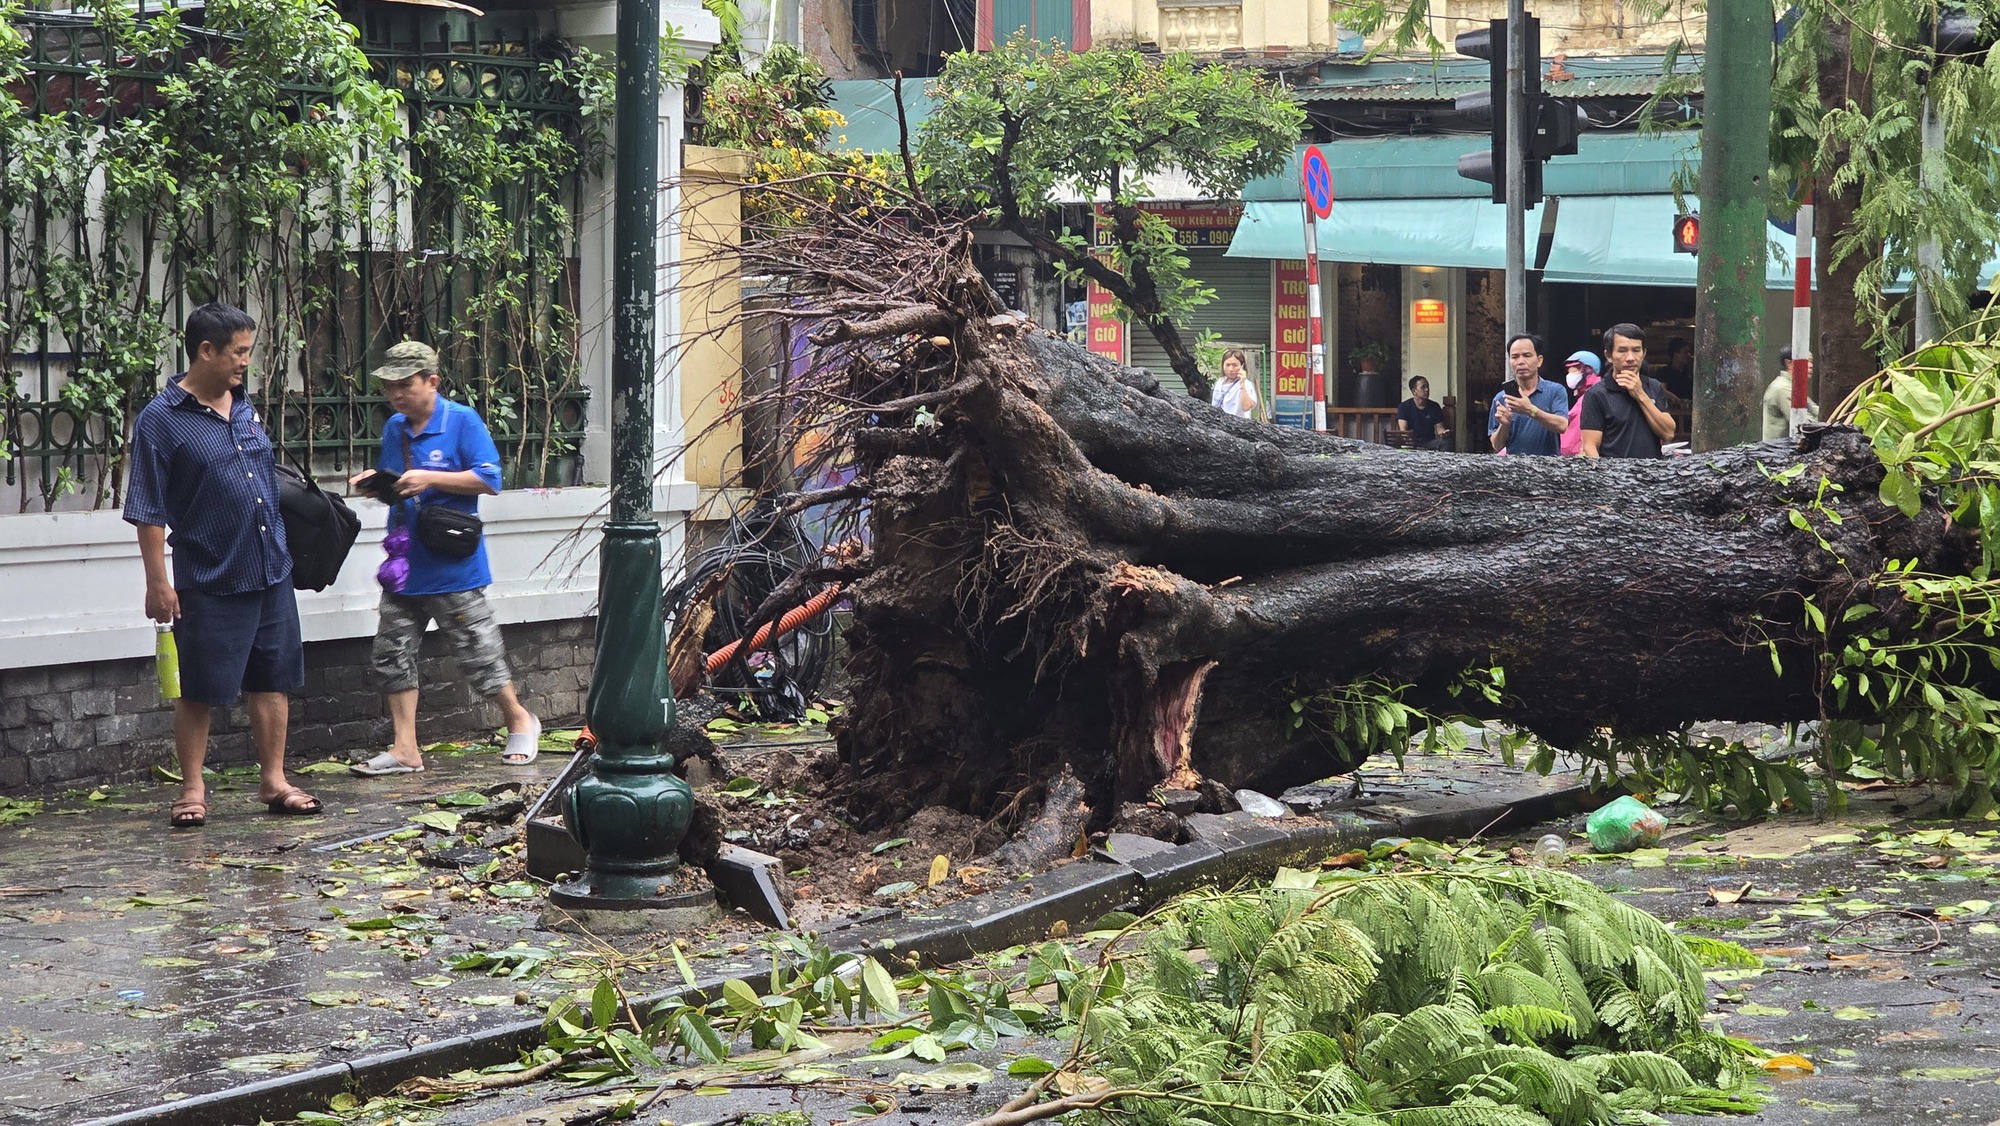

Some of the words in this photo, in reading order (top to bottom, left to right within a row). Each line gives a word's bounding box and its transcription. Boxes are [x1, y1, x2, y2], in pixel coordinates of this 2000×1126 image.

[1189, 214, 1213, 227] KIỆN
[1094, 323, 1117, 342] GIỜ
[1283, 325, 1306, 344] GIỜ
[1281, 353, 1307, 370] QUA
